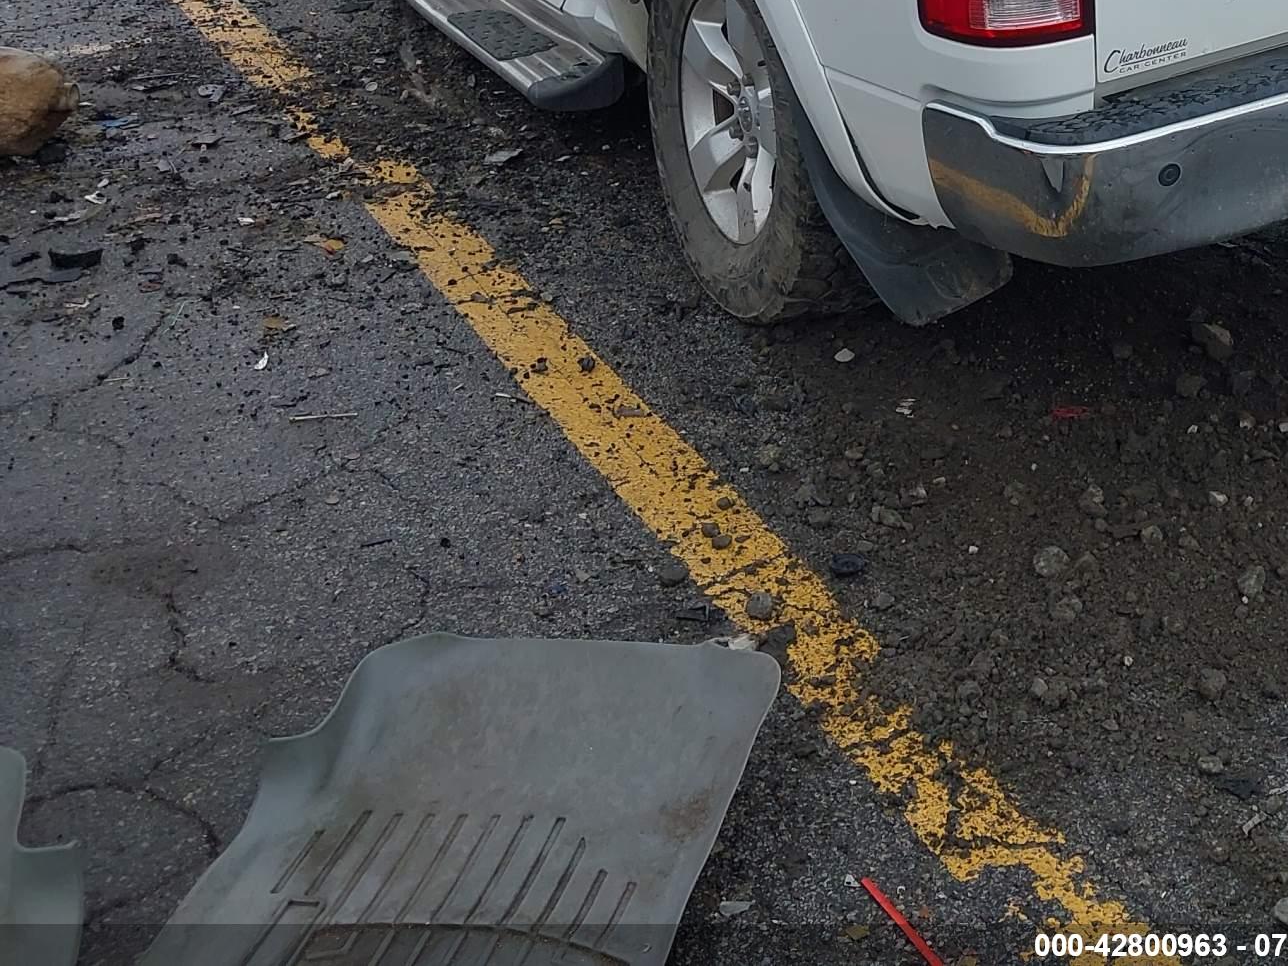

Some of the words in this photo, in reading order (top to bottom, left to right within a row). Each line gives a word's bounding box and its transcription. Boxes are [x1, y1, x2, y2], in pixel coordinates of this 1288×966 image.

[1103, 38, 1188, 73] Charbonneau
[1119, 65, 1140, 74] CAR
[1144, 51, 1187, 67] CENTER
